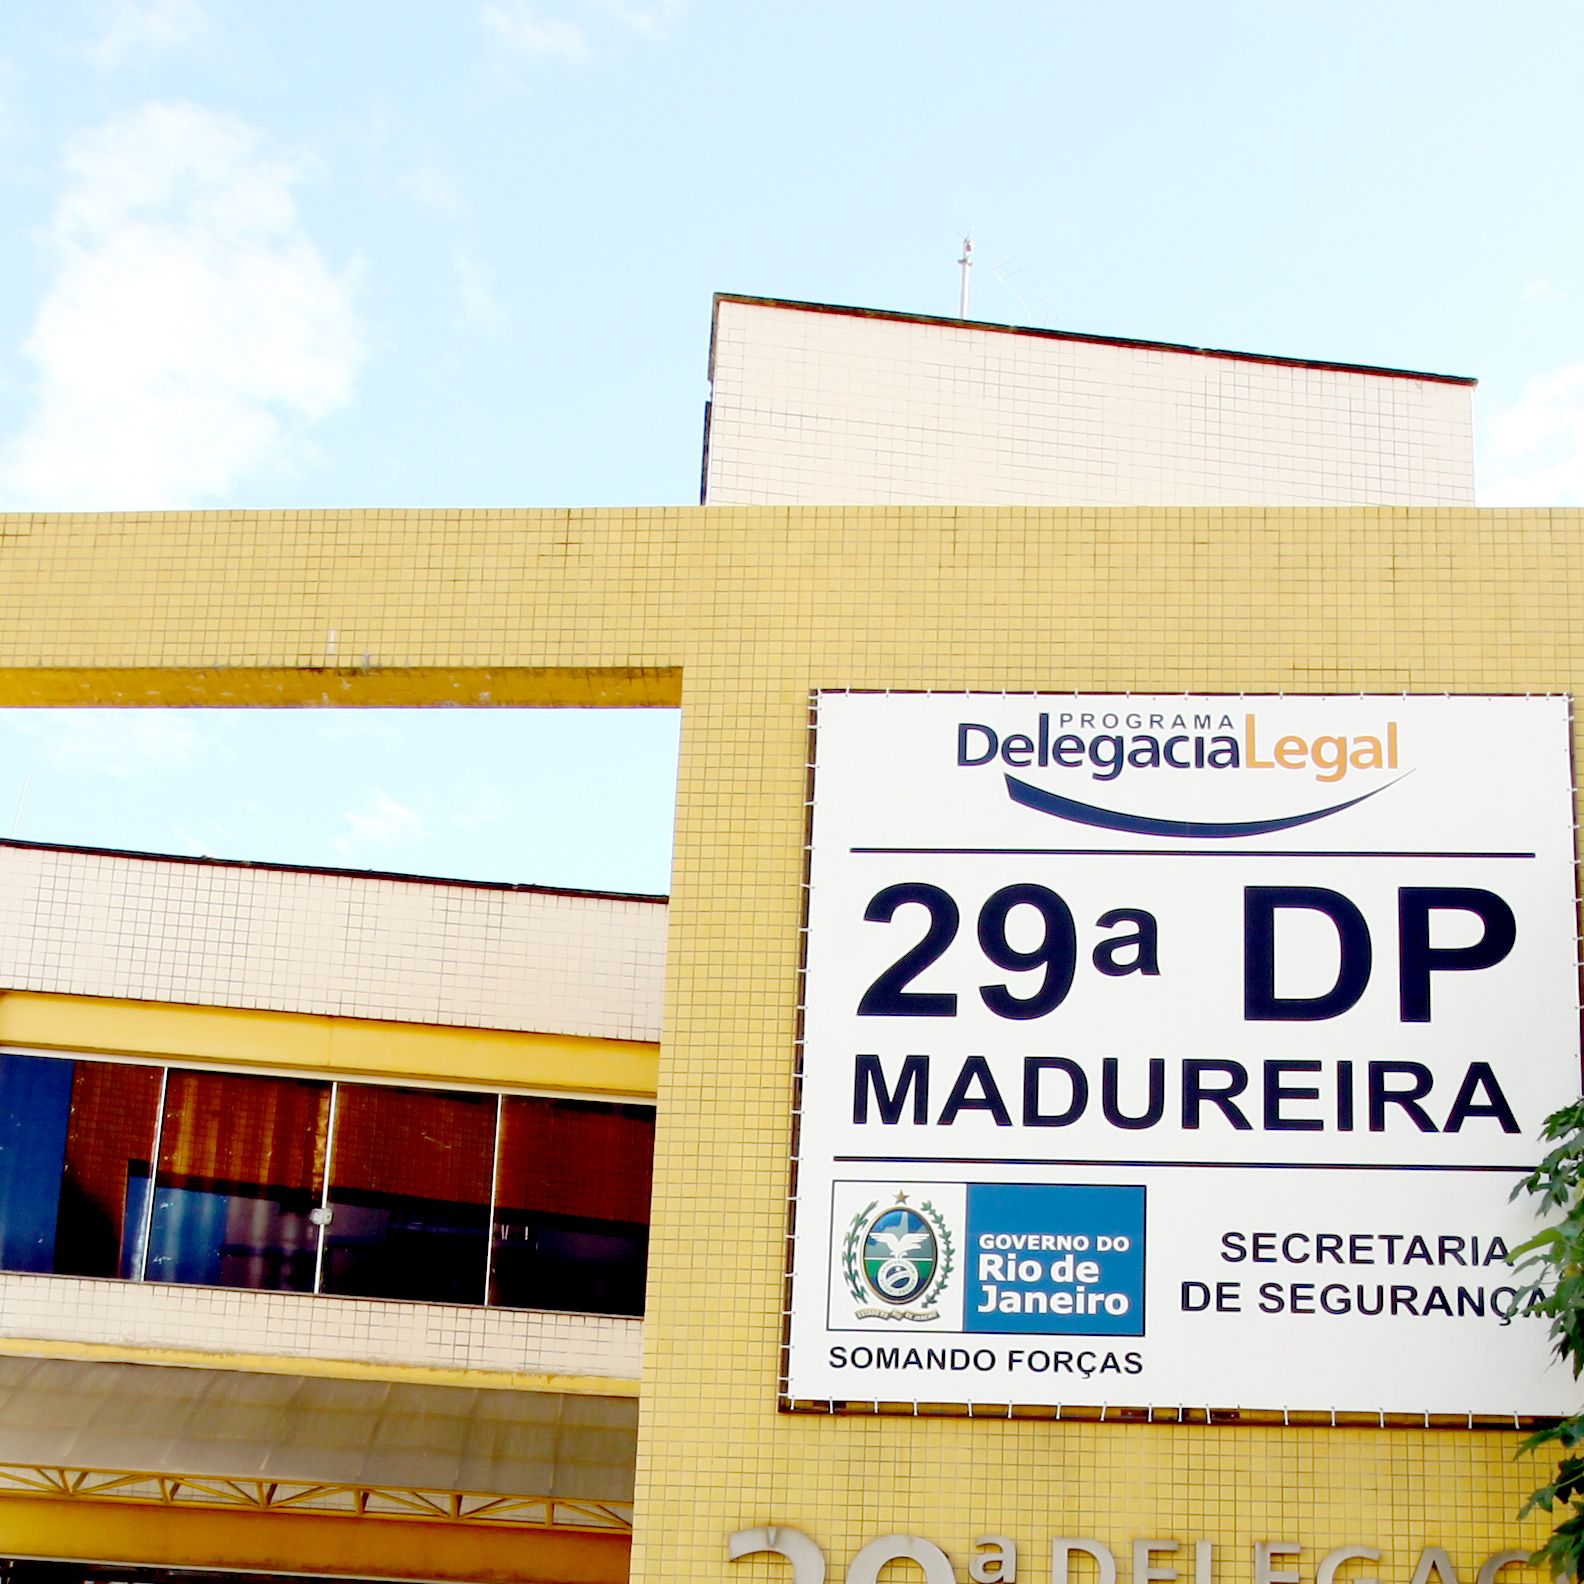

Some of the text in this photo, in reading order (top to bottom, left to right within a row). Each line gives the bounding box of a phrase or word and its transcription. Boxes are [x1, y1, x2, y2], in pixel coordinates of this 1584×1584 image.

[1059, 713, 1234, 730] PROGRAMA
[1242, 885, 1517, 1023] DP
[852, 1054, 1522, 1134] MADUREIRA
[978, 1233, 1130, 1252] GOVERNO DO
[1220, 1232, 1514, 1267] SECRETARIA
[978, 1253, 1100, 1284] Rio de
[978, 1284, 1130, 1316] Janeiro
[1181, 1281, 1242, 1313] DE
[828, 1346, 1144, 1380] SOMANDO FORÇAS
